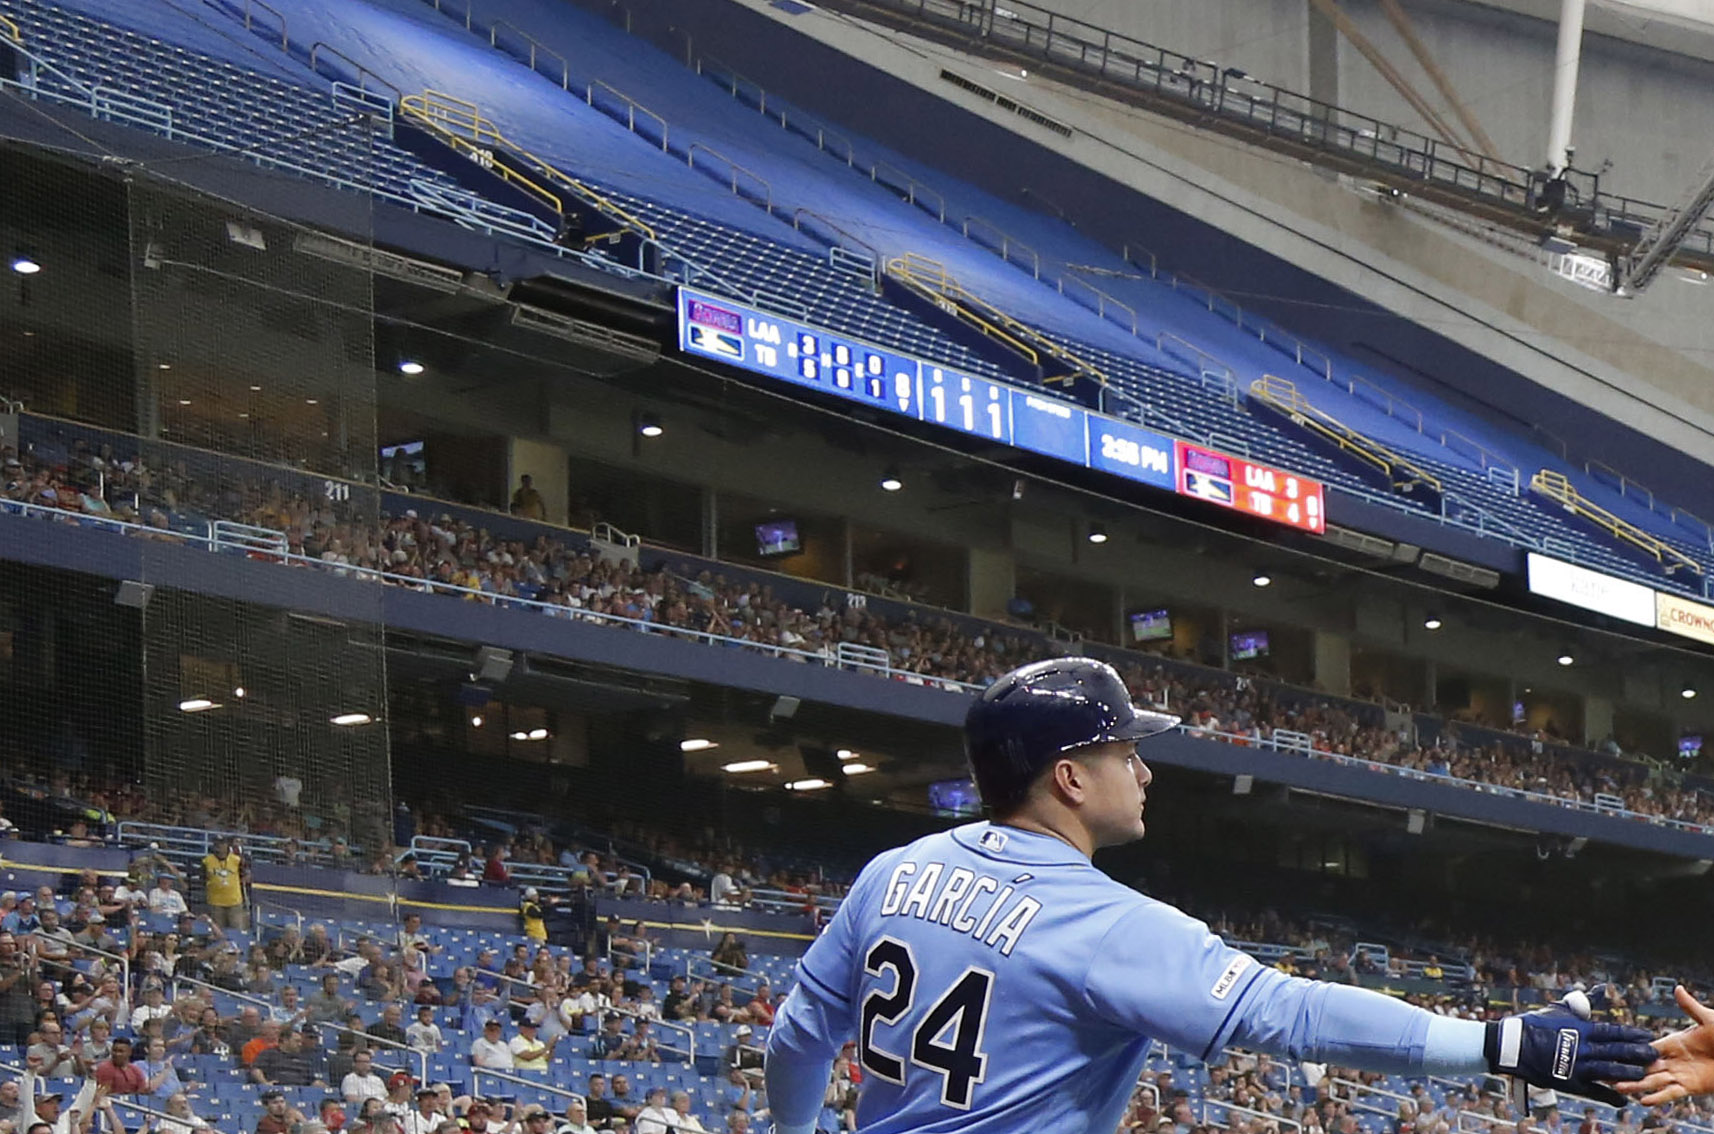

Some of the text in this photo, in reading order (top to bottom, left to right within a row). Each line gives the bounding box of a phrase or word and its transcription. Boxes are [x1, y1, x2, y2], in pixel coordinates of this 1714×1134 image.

[748, 318, 781, 344] LAA
[755, 344, 777, 366] TB
[932, 386, 944, 421] 1
[960, 395, 973, 430] 1
[988, 403, 1001, 438] 1
[1141, 446, 1168, 473] PM
[1246, 466, 1275, 491] LAA
[1251, 492, 1271, 515] TB
[880, 860, 1042, 958] GARCÍA
[859, 934, 996, 1112] 24
